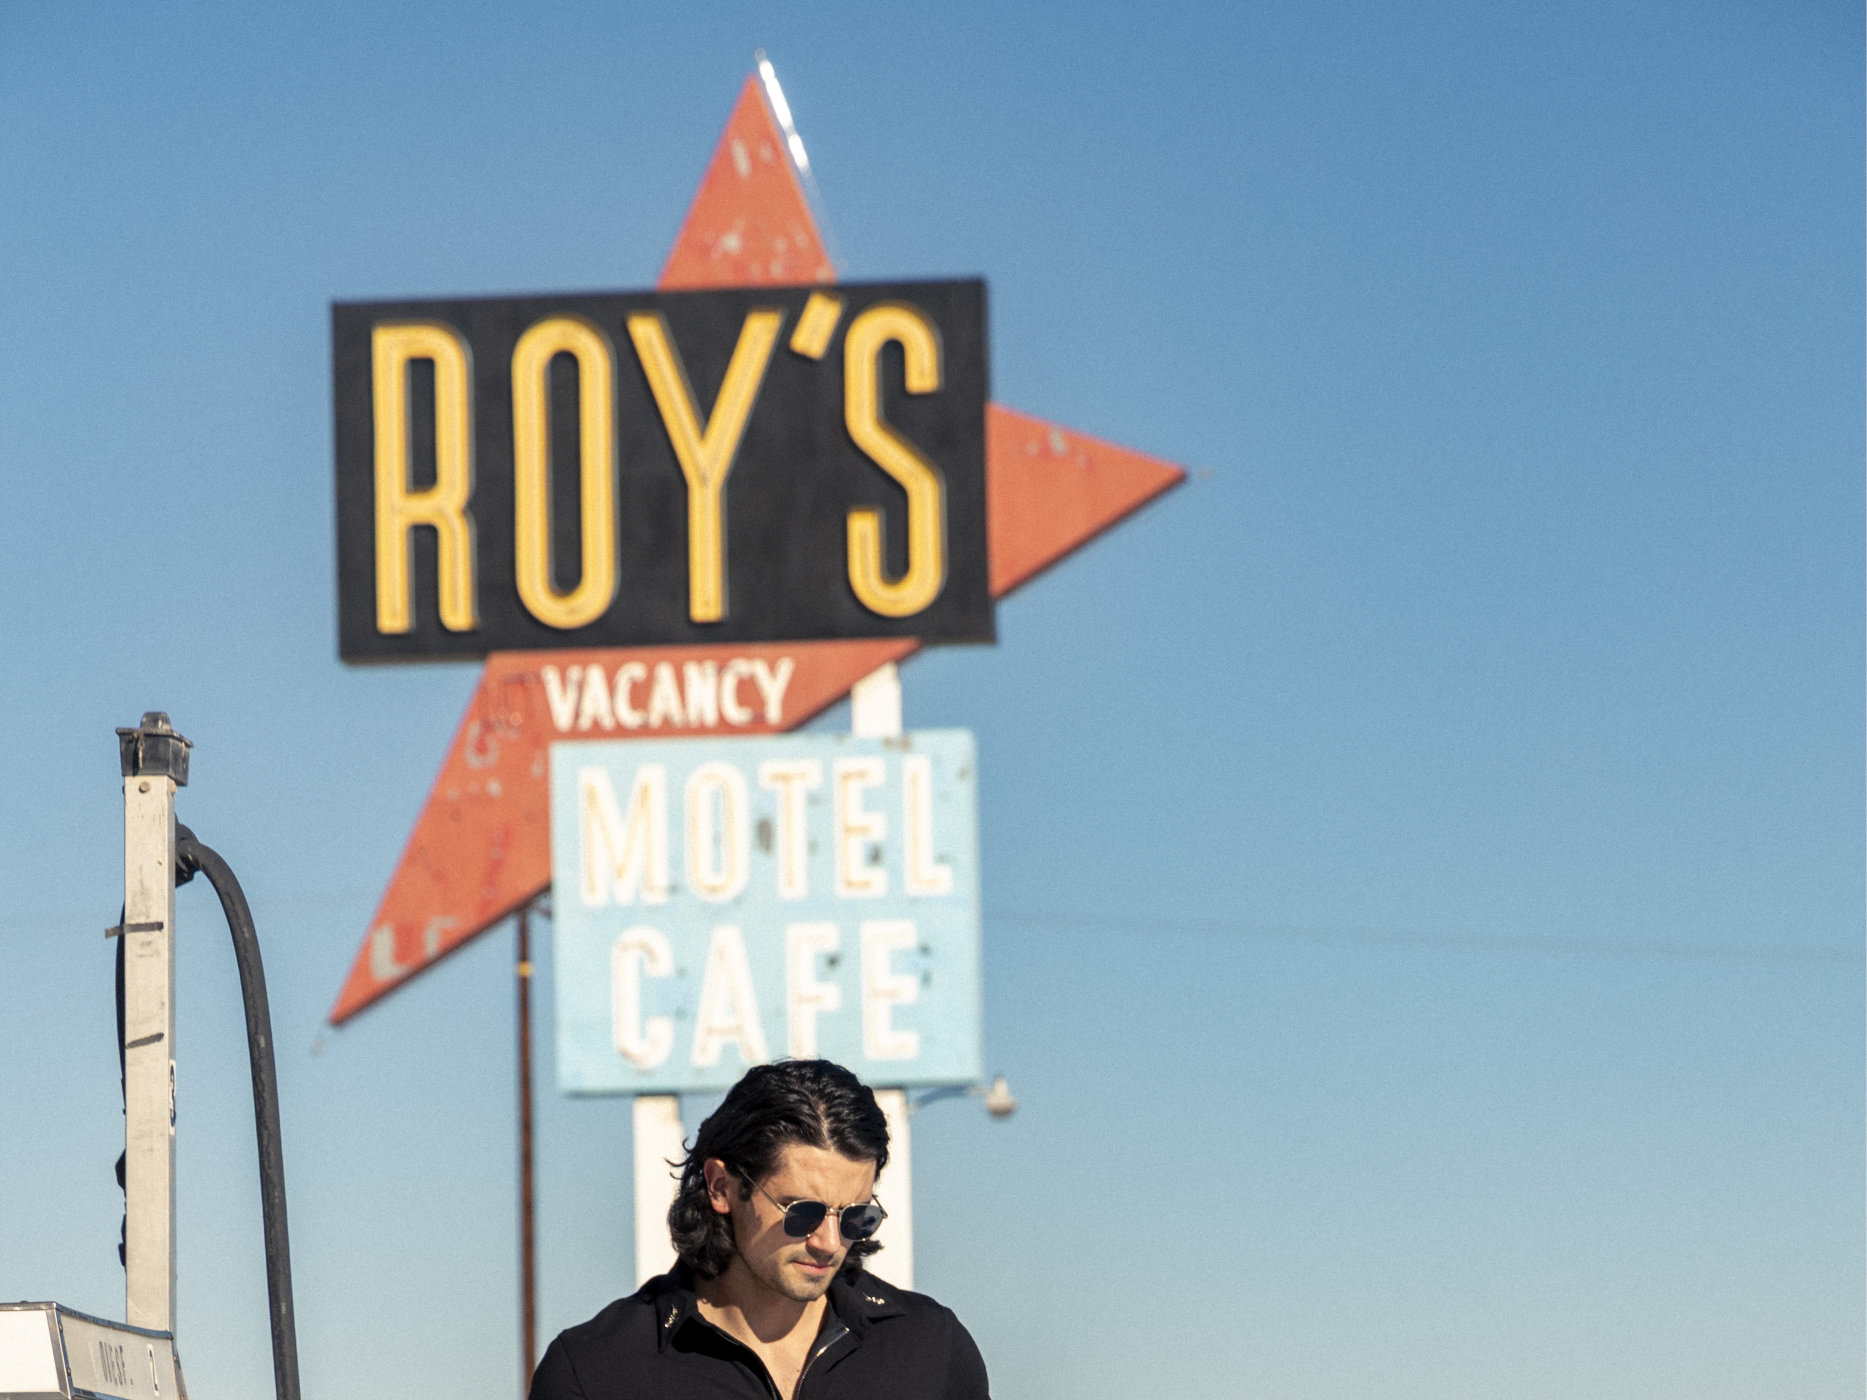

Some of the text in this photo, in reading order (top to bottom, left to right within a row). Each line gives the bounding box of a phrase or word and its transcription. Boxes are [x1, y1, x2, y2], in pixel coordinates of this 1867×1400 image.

[371, 290, 947, 635] ROY'S
[541, 656, 796, 732] VACANCY
[577, 753, 954, 907] MOTEL
[610, 918, 921, 1070] CAFE
